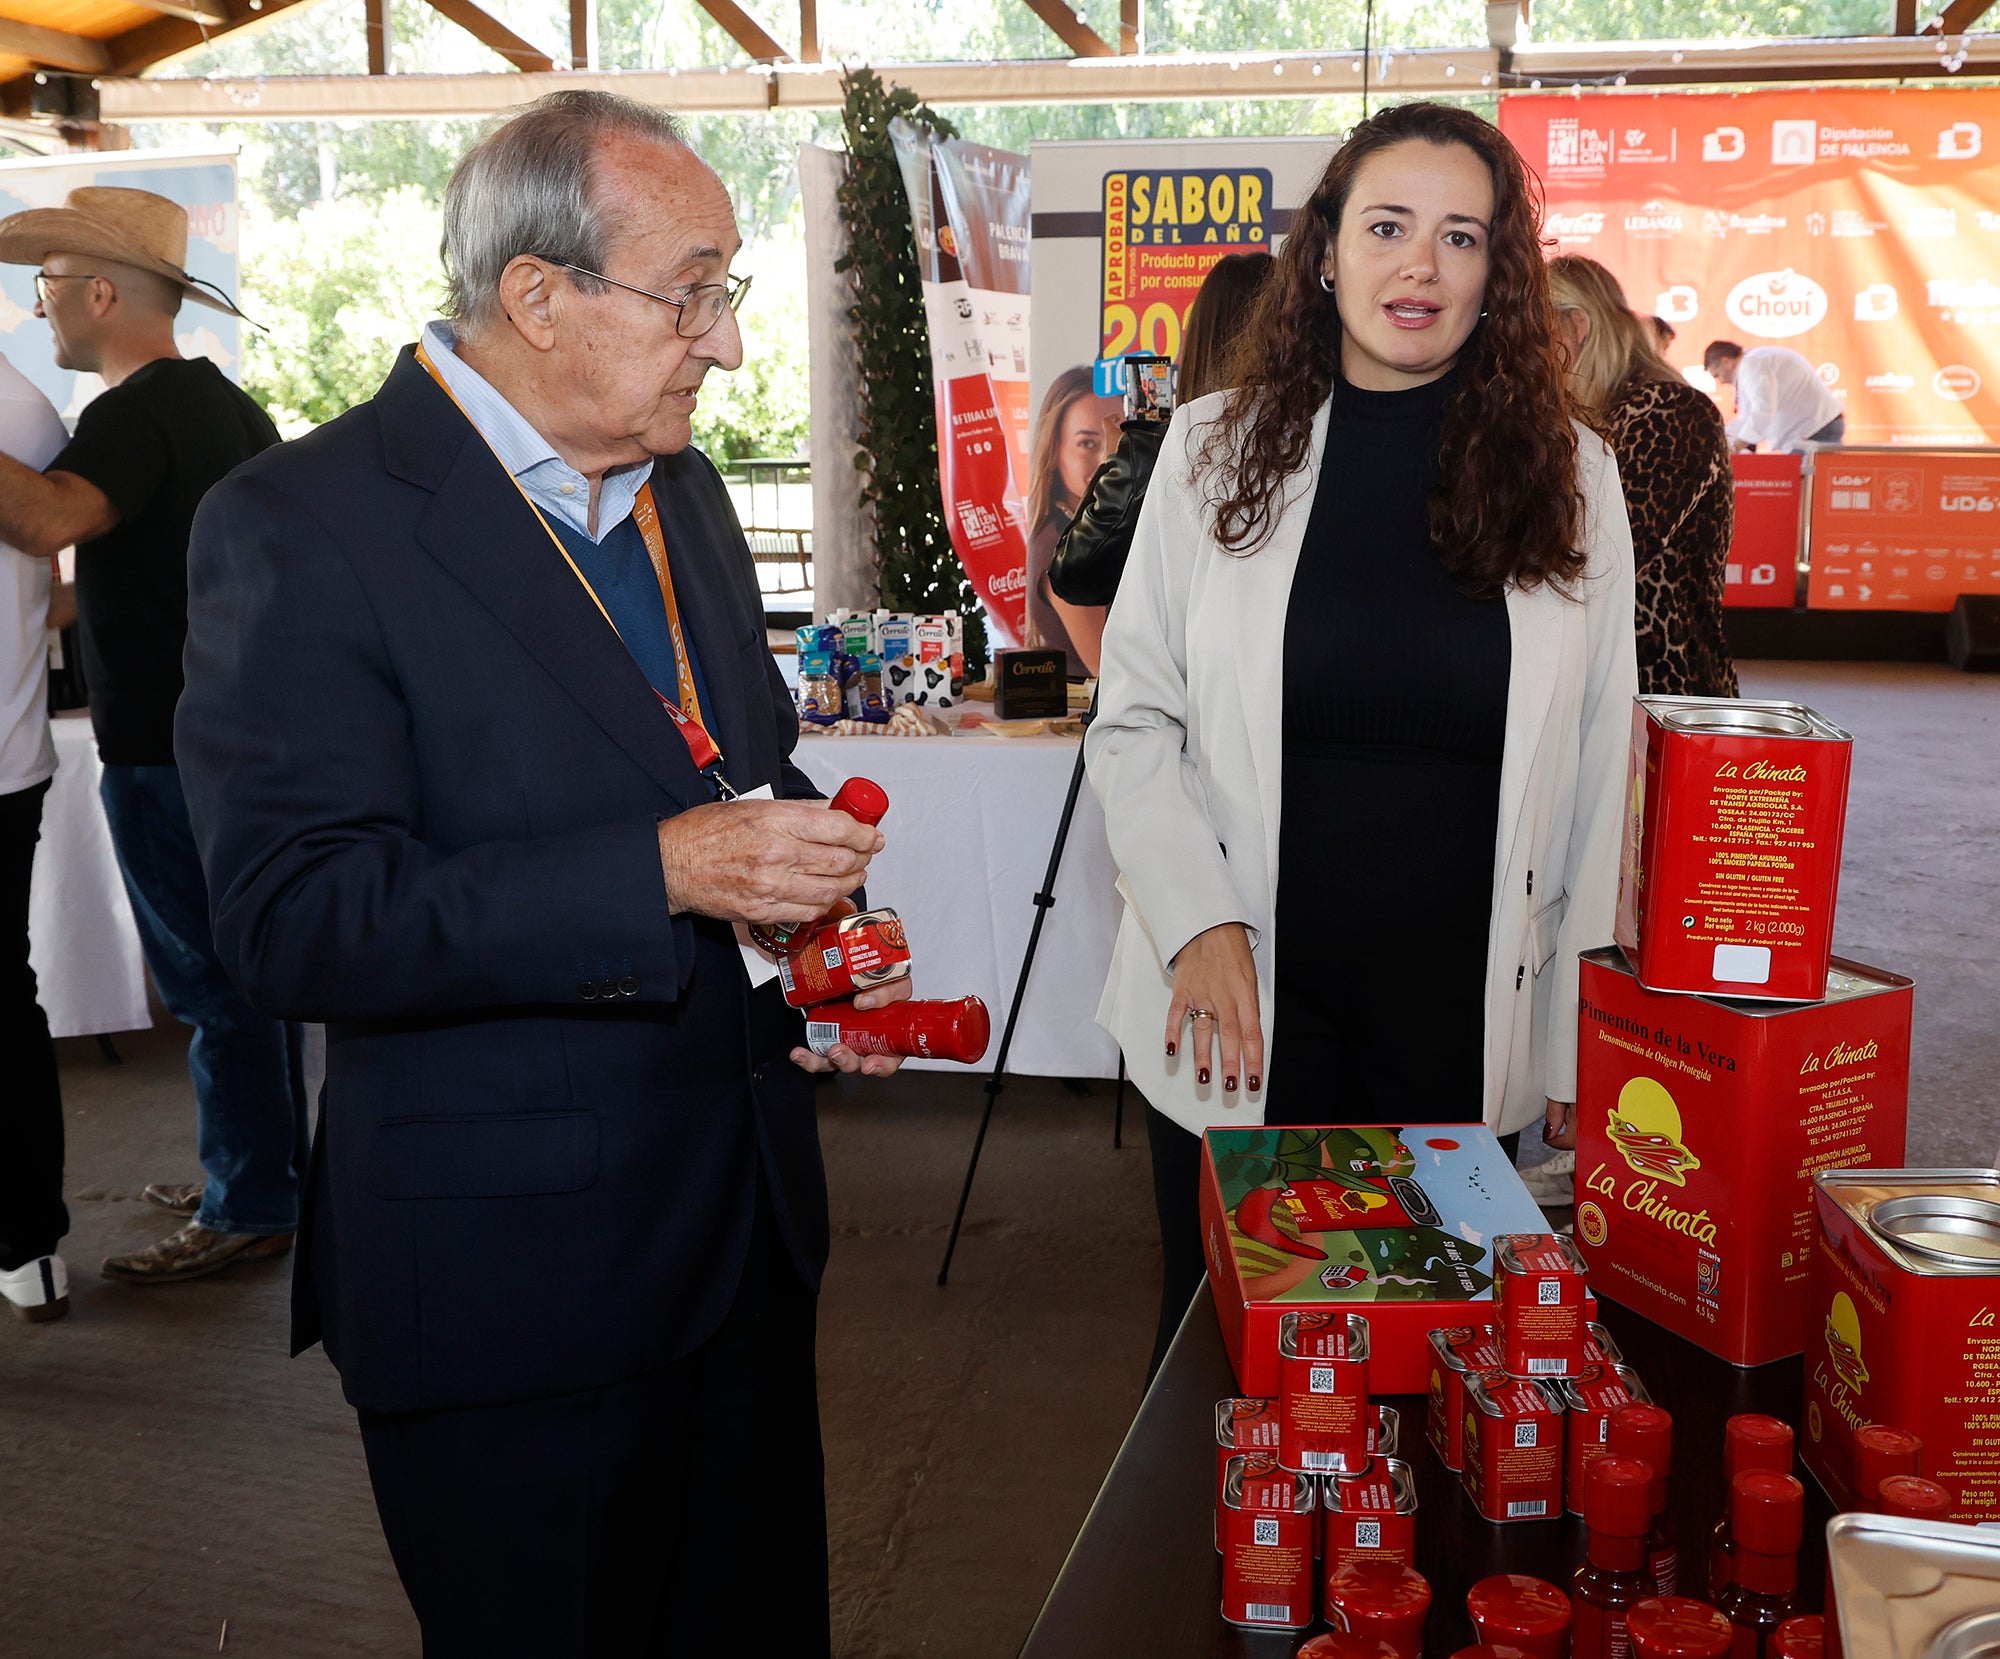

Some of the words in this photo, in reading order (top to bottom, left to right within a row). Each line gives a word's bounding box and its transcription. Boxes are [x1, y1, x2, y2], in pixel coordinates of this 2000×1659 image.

[1580, 129, 1598, 140] PA
[1820, 127, 1893, 142] Diputación
[1820, 144, 1839, 156] DE
[1842, 143, 1910, 156] PALENCIA
[1131, 174, 1263, 225] SABOR
[1624, 216, 1683, 230] LEBANZA
[1109, 180, 1124, 297] APROBADO
[1131, 228, 1181, 243] DEL
[1204, 223, 1264, 242] AÑO
[1141, 253, 1195, 268] Producto
[1141, 275, 1160, 291] por
[1739, 290, 1815, 316] Choví
[1715, 761, 1738, 779] La
[1743, 760, 1807, 782] Chinata
[1713, 786, 1747, 794] Envasado
[1748, 788, 1791, 797] por/Packed
[1750, 796, 1789, 804] EXTREMEÑA
[1729, 830, 1753, 838] ESPAÑA
[1755, 832, 1779, 840] (SPAIN)
[1723, 859, 1747, 867] SMOKED
[1771, 862, 1795, 870] POWDER
[1730, 852, 1758, 861] PIMENTÓN
[1759, 855, 1787, 863] AHUMADO
[1726, 873, 1746, 881] GLUTEN
[1716, 924, 1734, 932] weight
[1745, 920, 1752, 931] 2
[1754, 921, 1766, 934] kg
[1767, 922, 1805, 936] (2.000g)
[1724, 936, 1746, 944] España
[1580, 998, 1649, 1040] Pimentón
[1654, 1028, 1673, 1048] de
[1677, 1034, 1691, 1056] la
[1697, 1040, 1736, 1072] Vera
[1598, 1029, 1645, 1055] Denominación
[1645, 1047, 1653, 1059] de
[1654, 1051, 1678, 1069] Origen
[1679, 1060, 1712, 1082] Protegida
[1800, 1052, 1820, 1075] La
[1824, 1039, 1878, 1070] Chinata
[1799, 1082, 1829, 1095] Envasado
[1809, 1103, 1825, 1114] CTRA.
[1819, 1108, 1847, 1121] PLASENCIA
[1852, 1103, 1874, 1114] ESPAÑA
[1815, 1149, 1841, 1163] PIMENTÓN
[1831, 1157, 1851, 1169] PAPRIKA
[1851, 1153, 1872, 1165] POWDER
[1585, 1163, 1616, 1200] La
[1622, 1179, 1718, 1248] Chinata
[1611, 1261, 1687, 1306] www.lachinata.com
[1969, 1307, 1995, 1326] La
[1813, 1360, 1829, 1395] La
[1962, 1490, 1978, 1498] Peso
[1974, 1498, 1996, 1507] weight
